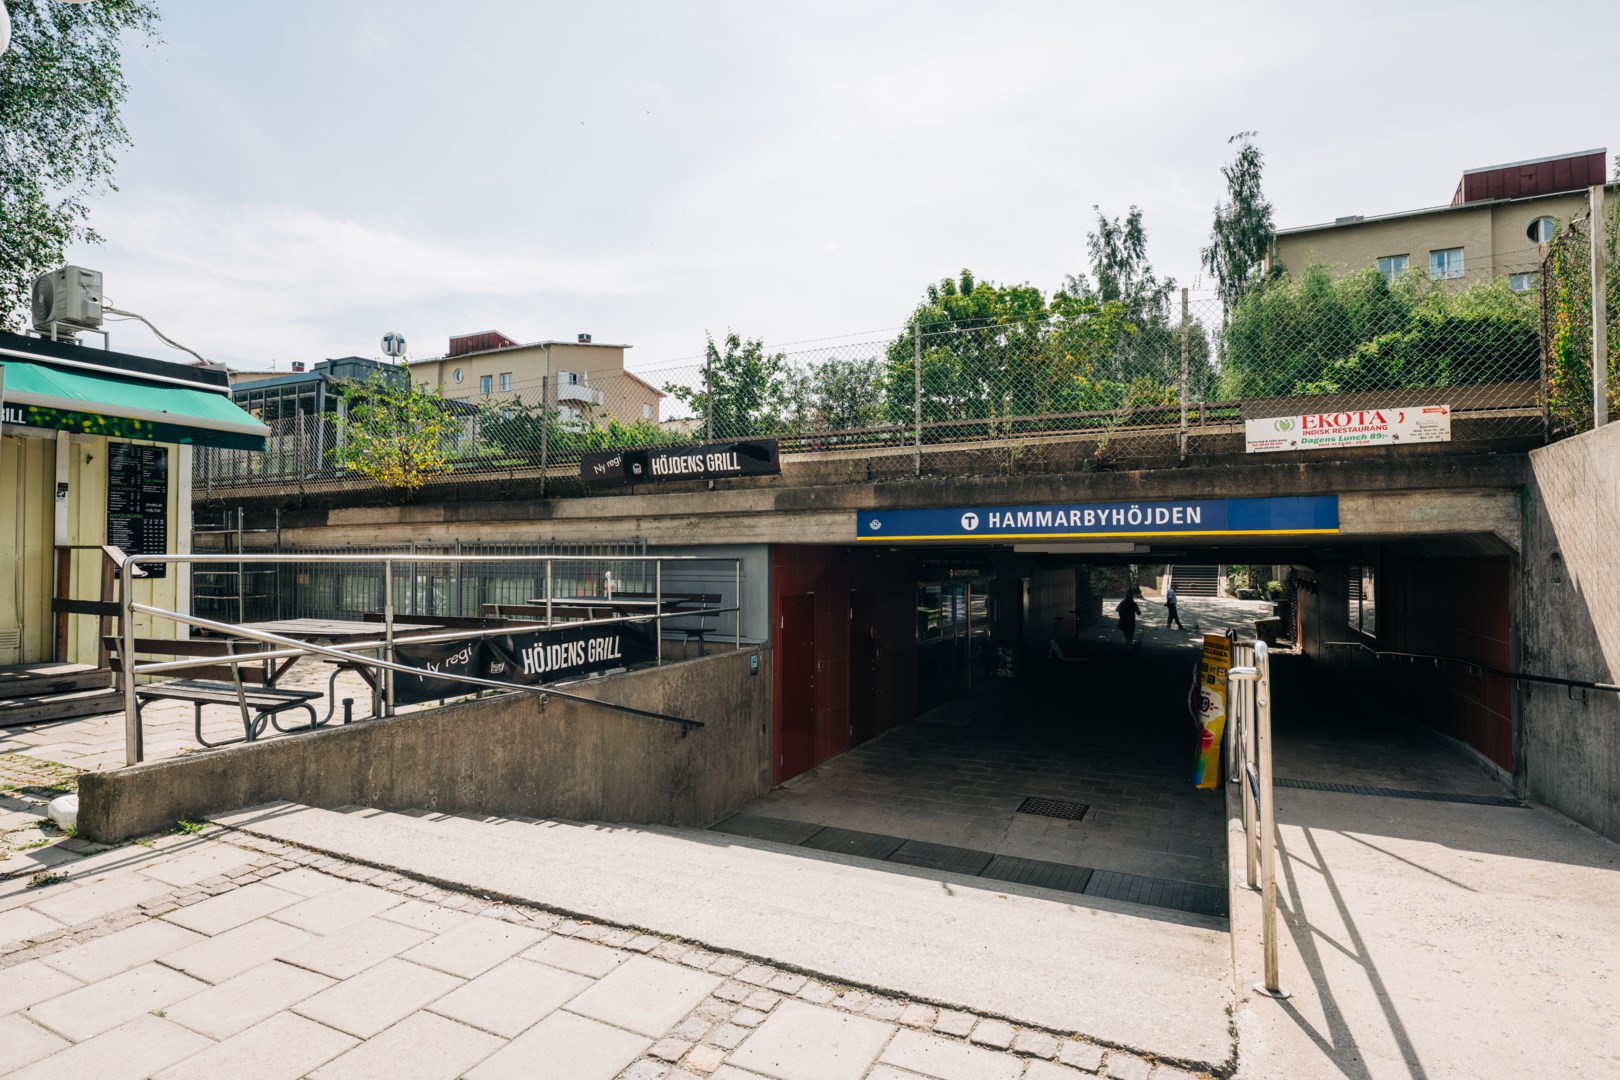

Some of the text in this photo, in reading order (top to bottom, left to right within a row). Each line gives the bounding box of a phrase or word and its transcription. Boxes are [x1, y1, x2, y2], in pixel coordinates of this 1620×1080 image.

[1302, 410, 1387, 429] EKOTA
[1332, 425, 1388, 434] RESTAURANG
[1301, 436, 1336, 444] Dagens
[1339, 433, 1367, 441] Lunch
[593, 453, 622, 475] Ny regi
[652, 452, 741, 476] HÖJDENS GRILL
[988, 505, 1202, 529] HAMMARBYHÖJDEN
[445, 643, 472, 668] regi
[521, 635, 622, 675] HÖJDENS GRILL
